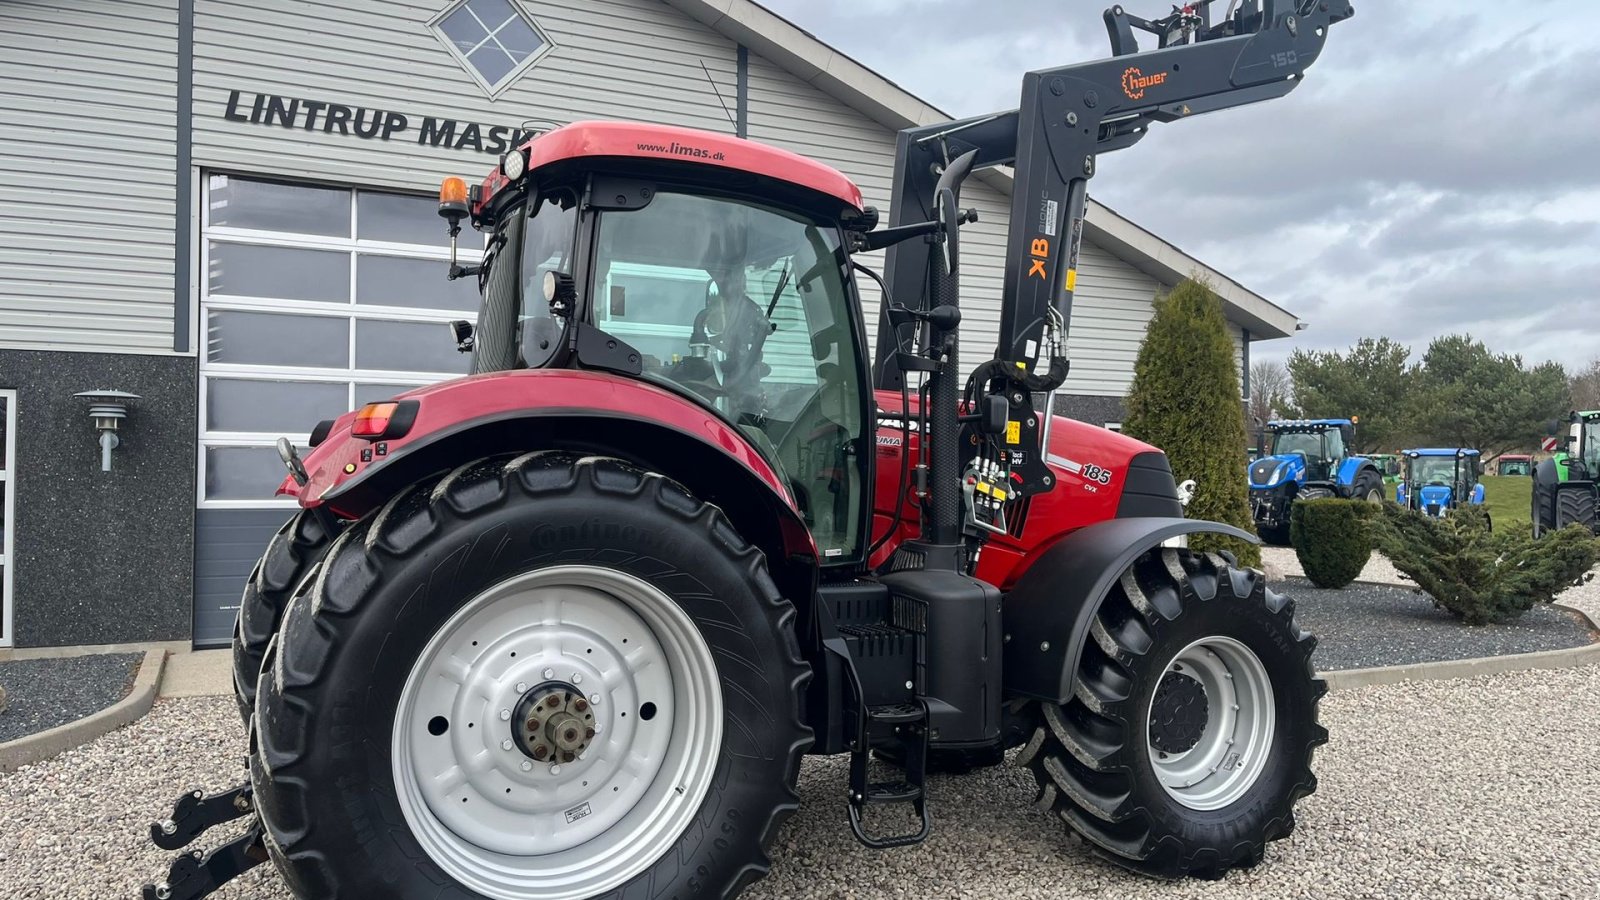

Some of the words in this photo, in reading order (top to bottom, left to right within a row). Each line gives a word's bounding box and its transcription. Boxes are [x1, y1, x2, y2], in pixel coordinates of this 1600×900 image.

[1269, 50, 1298, 69] 150
[1129, 71, 1168, 90] hauer
[224, 90, 408, 141] LINTRUP
[417, 117, 544, 155] MASK
[637, 142, 725, 161] www.limas.dk
[876, 435, 902, 447] UMA
[1083, 463, 1112, 485] 185
